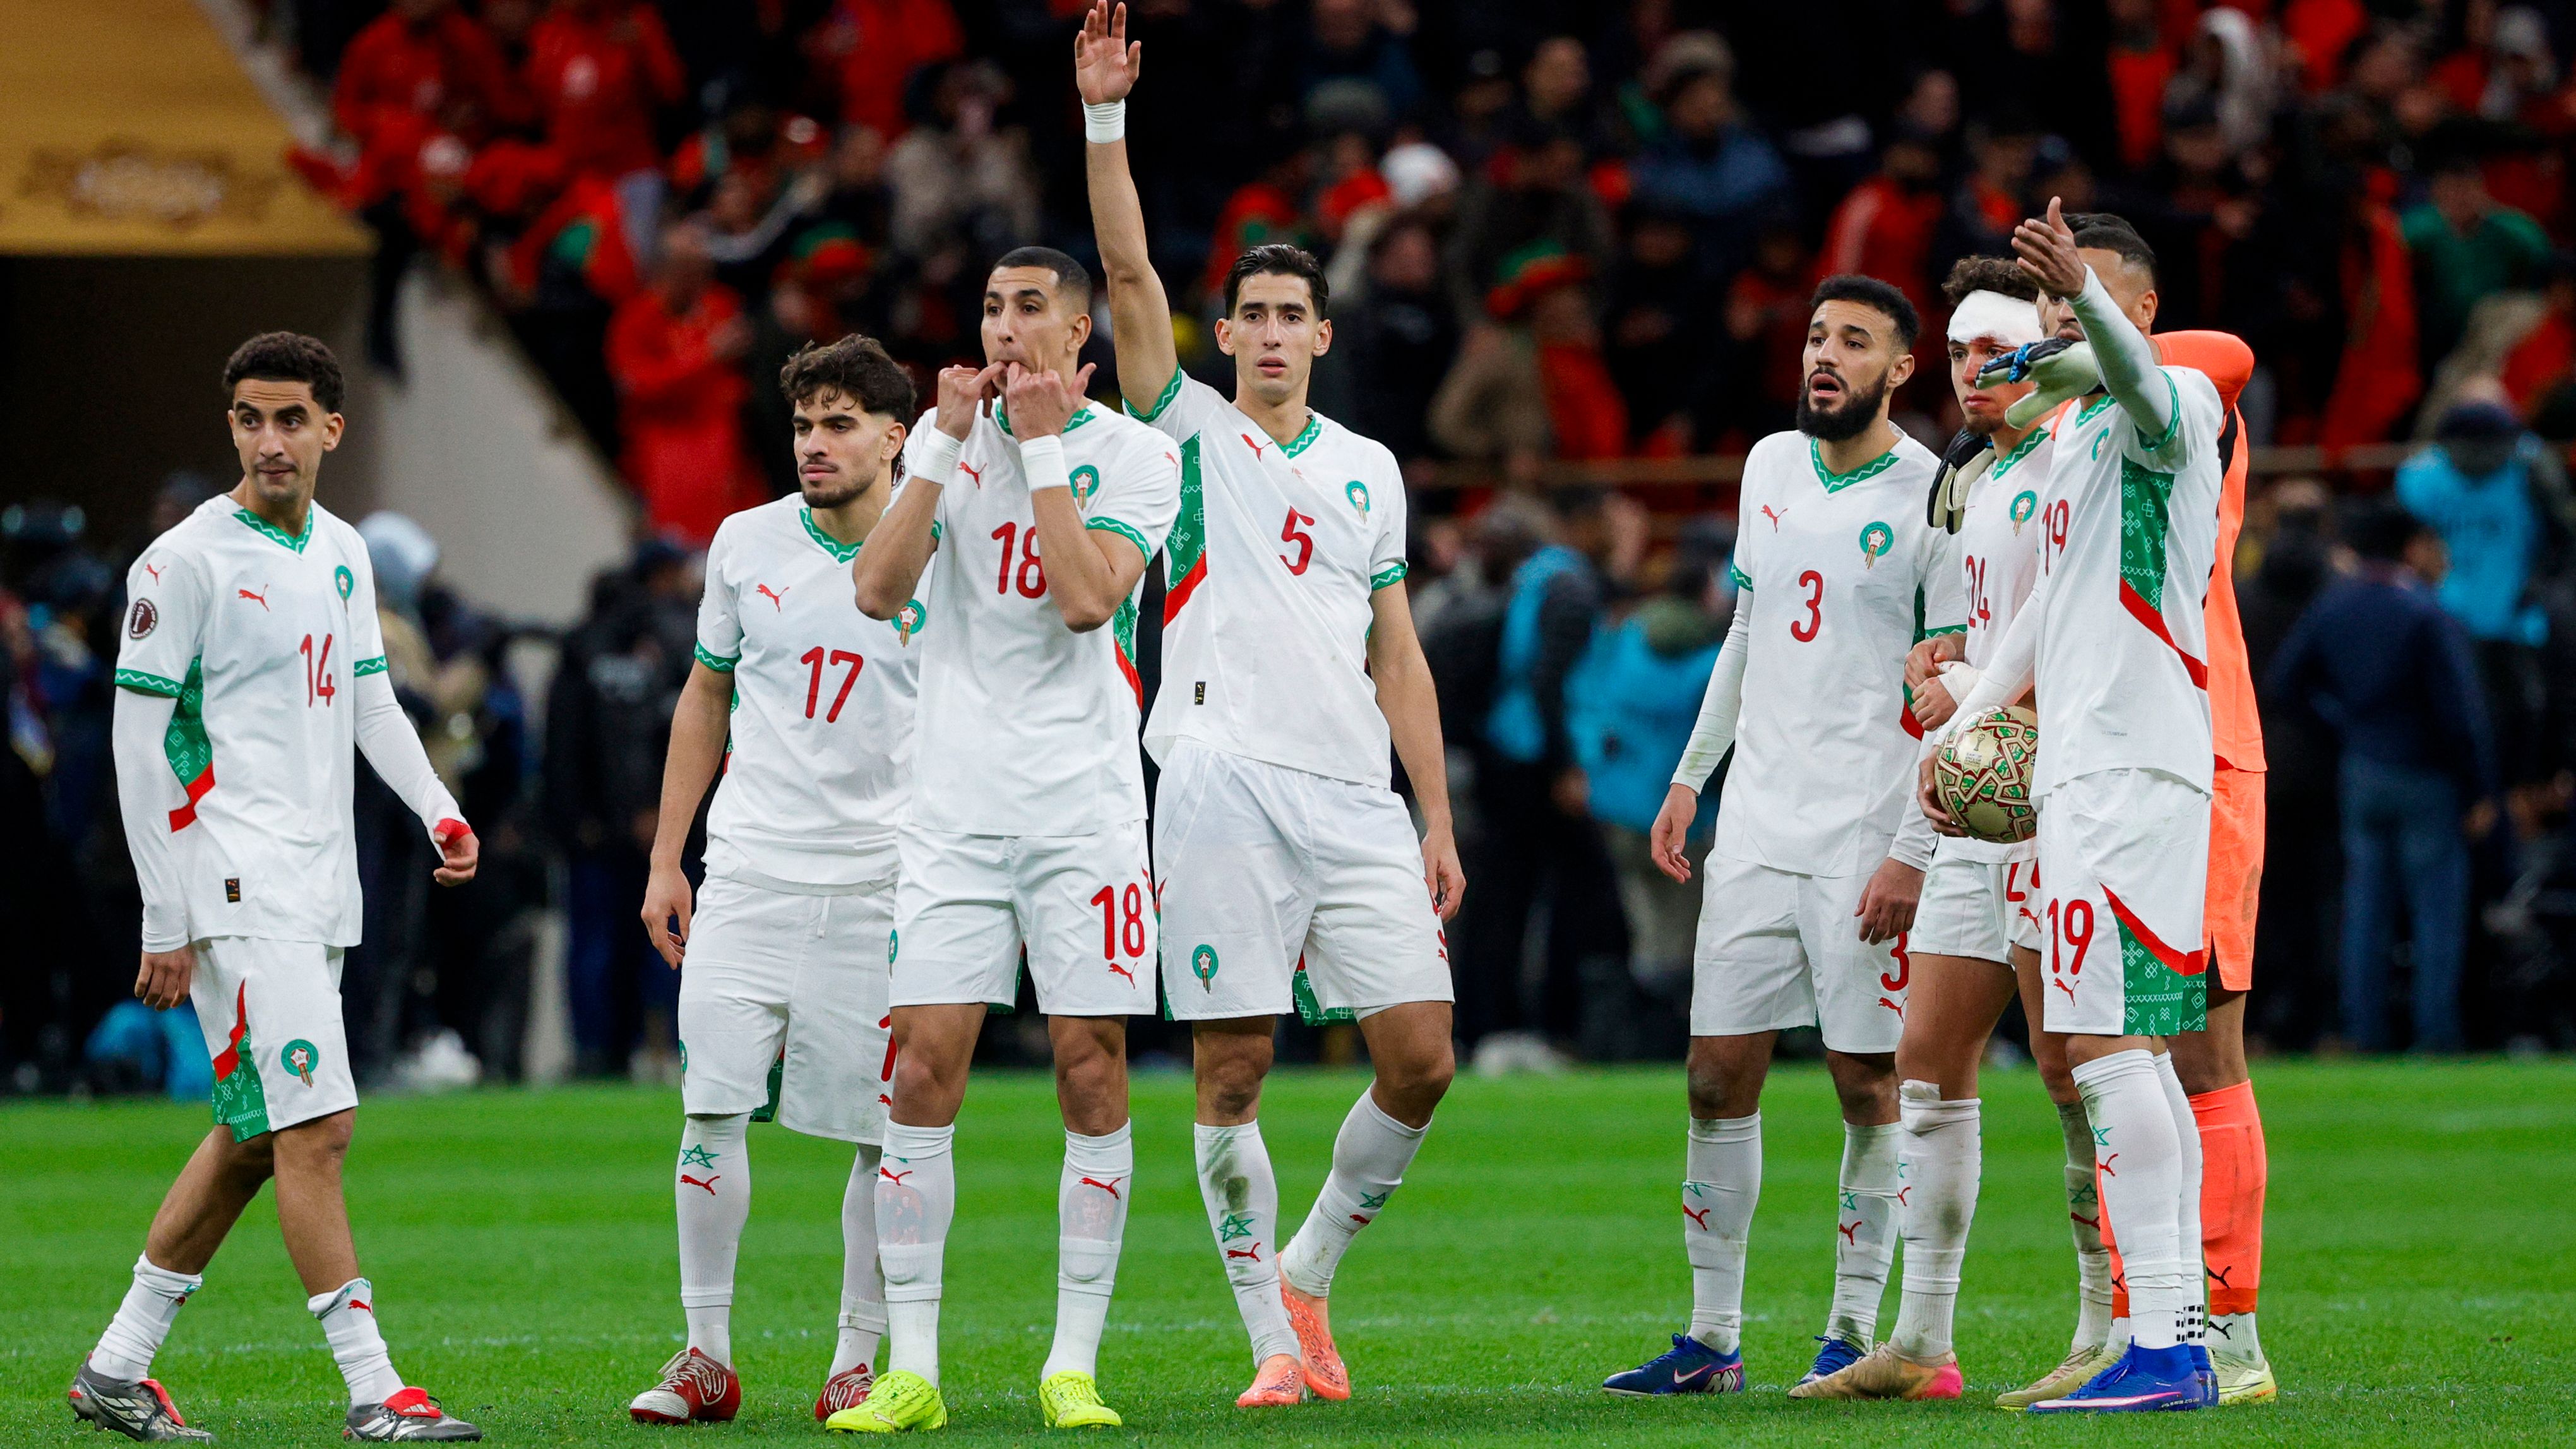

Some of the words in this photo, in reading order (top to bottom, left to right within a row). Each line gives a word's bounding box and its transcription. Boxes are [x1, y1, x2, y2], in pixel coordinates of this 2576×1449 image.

[991, 521, 1047, 599] 18
[1280, 506, 1315, 576] 5
[2042, 499, 2070, 577] 19
[1791, 570, 1823, 643] 3
[1965, 554, 1991, 631] 24
[299, 633, 335, 708] 14
[801, 646, 864, 724] 17
[1090, 883, 1145, 961] 18
[2046, 898, 2094, 975] 19
[1880, 931, 1910, 992] 3
